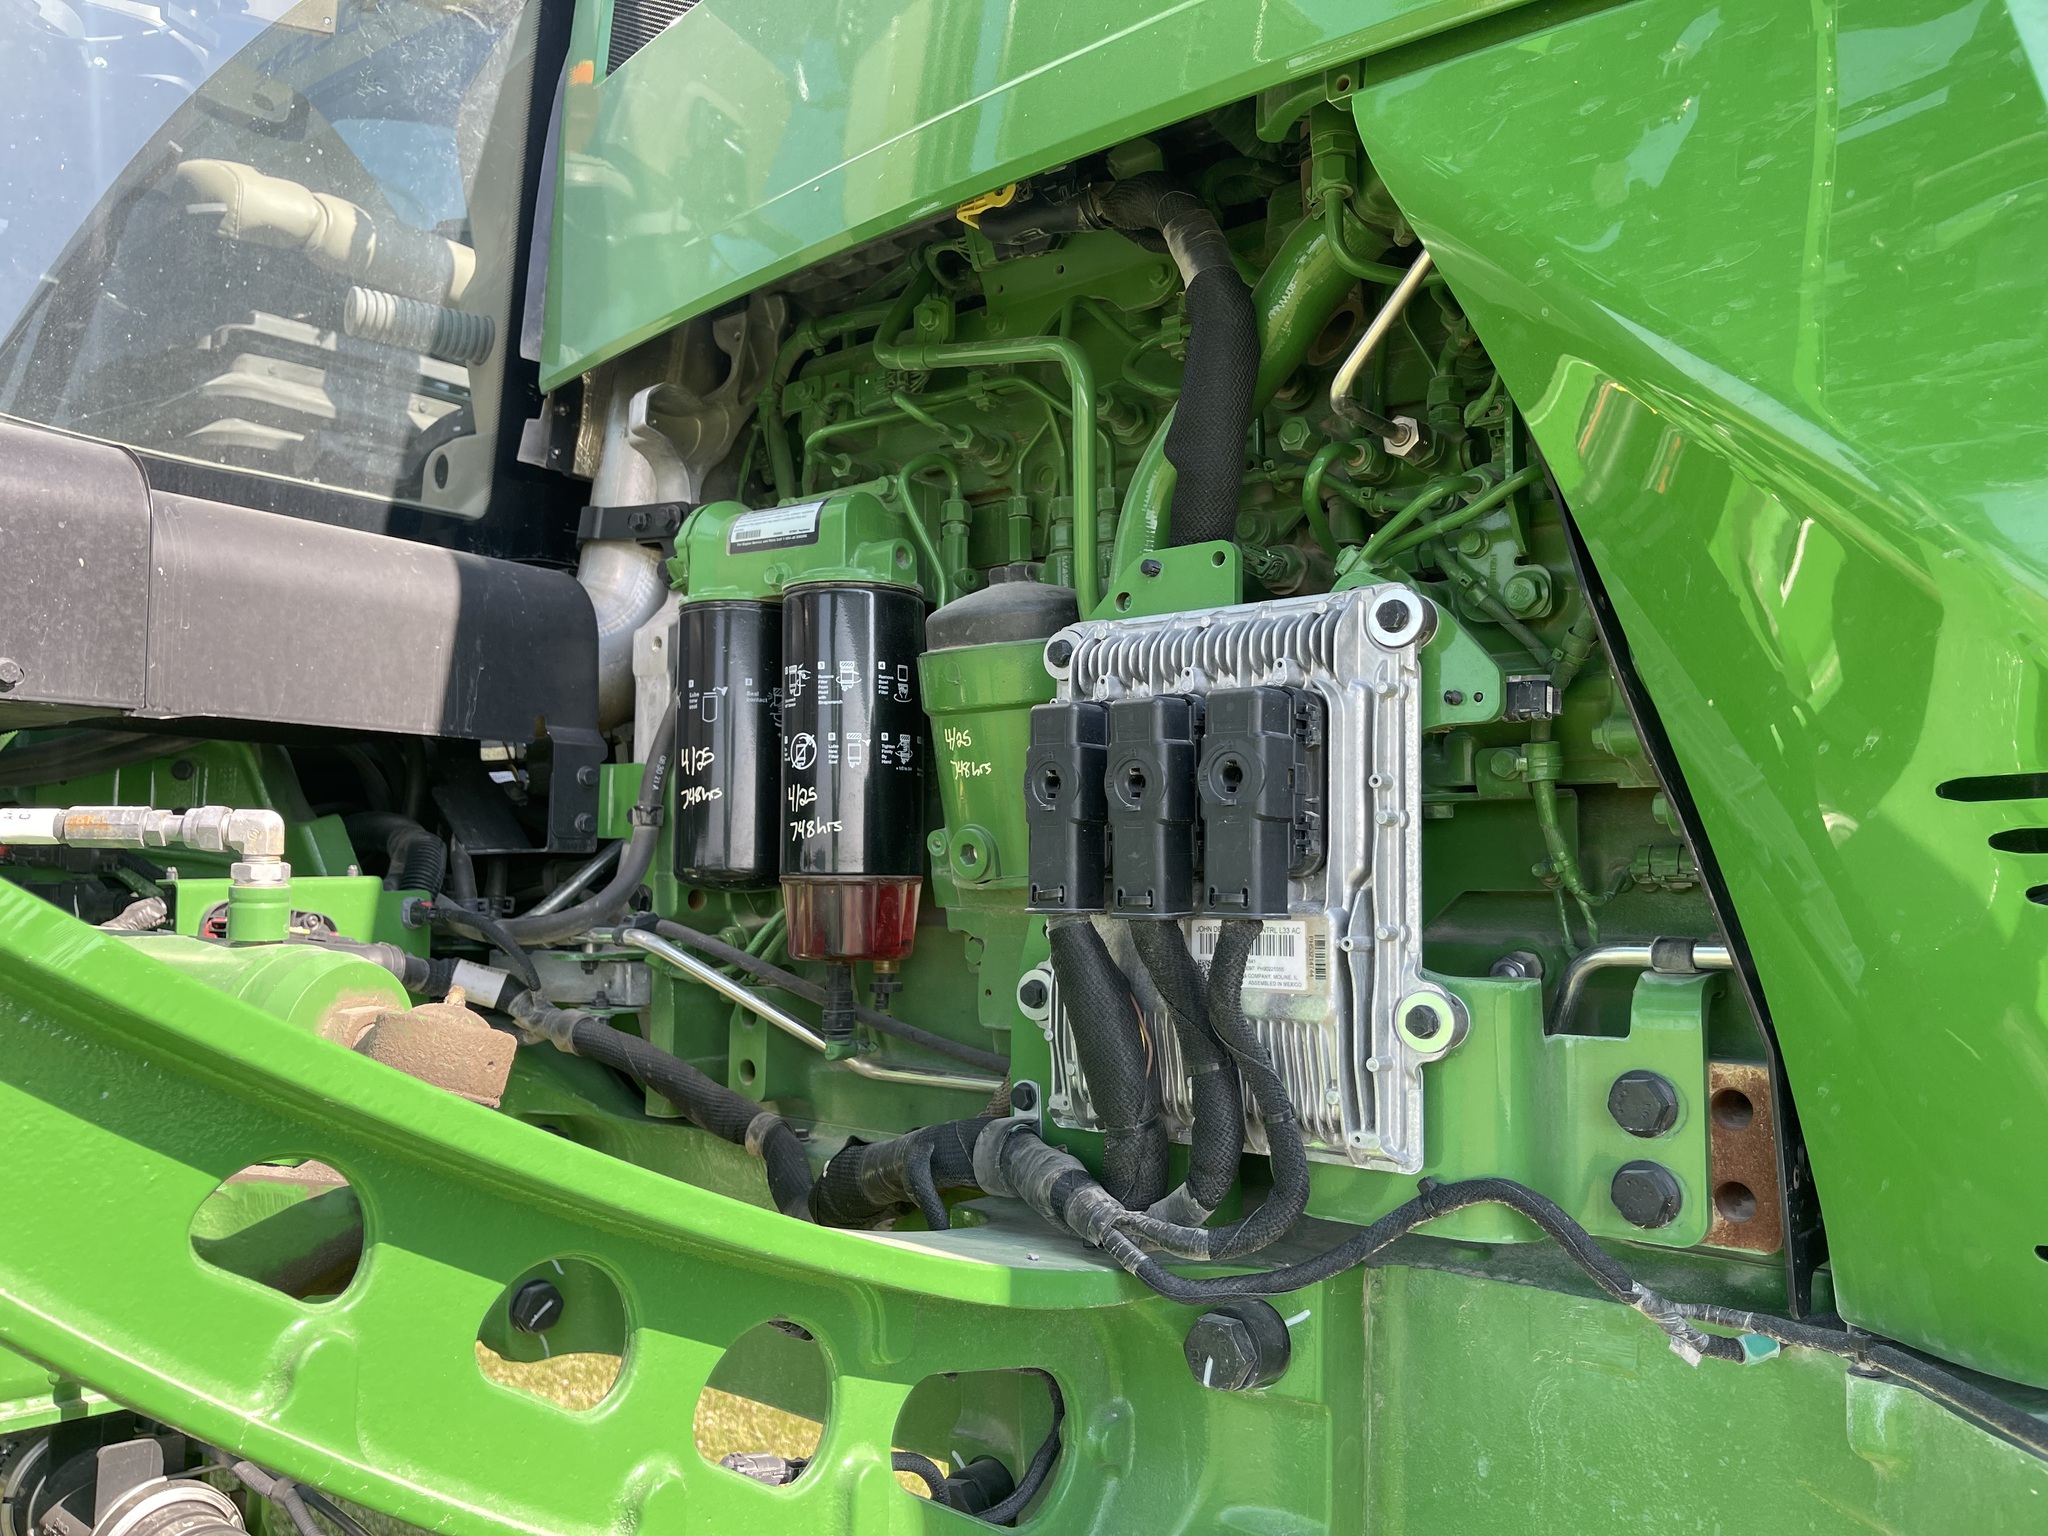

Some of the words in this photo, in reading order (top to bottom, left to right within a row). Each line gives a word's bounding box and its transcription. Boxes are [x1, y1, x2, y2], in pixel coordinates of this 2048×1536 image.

[944, 726, 972, 751] 4/25
[681, 745, 715, 776] 4/25
[788, 783, 818, 812] 4/25
[1195, 925, 1213, 933] JOHN
[1291, 927, 1301, 935] AC
